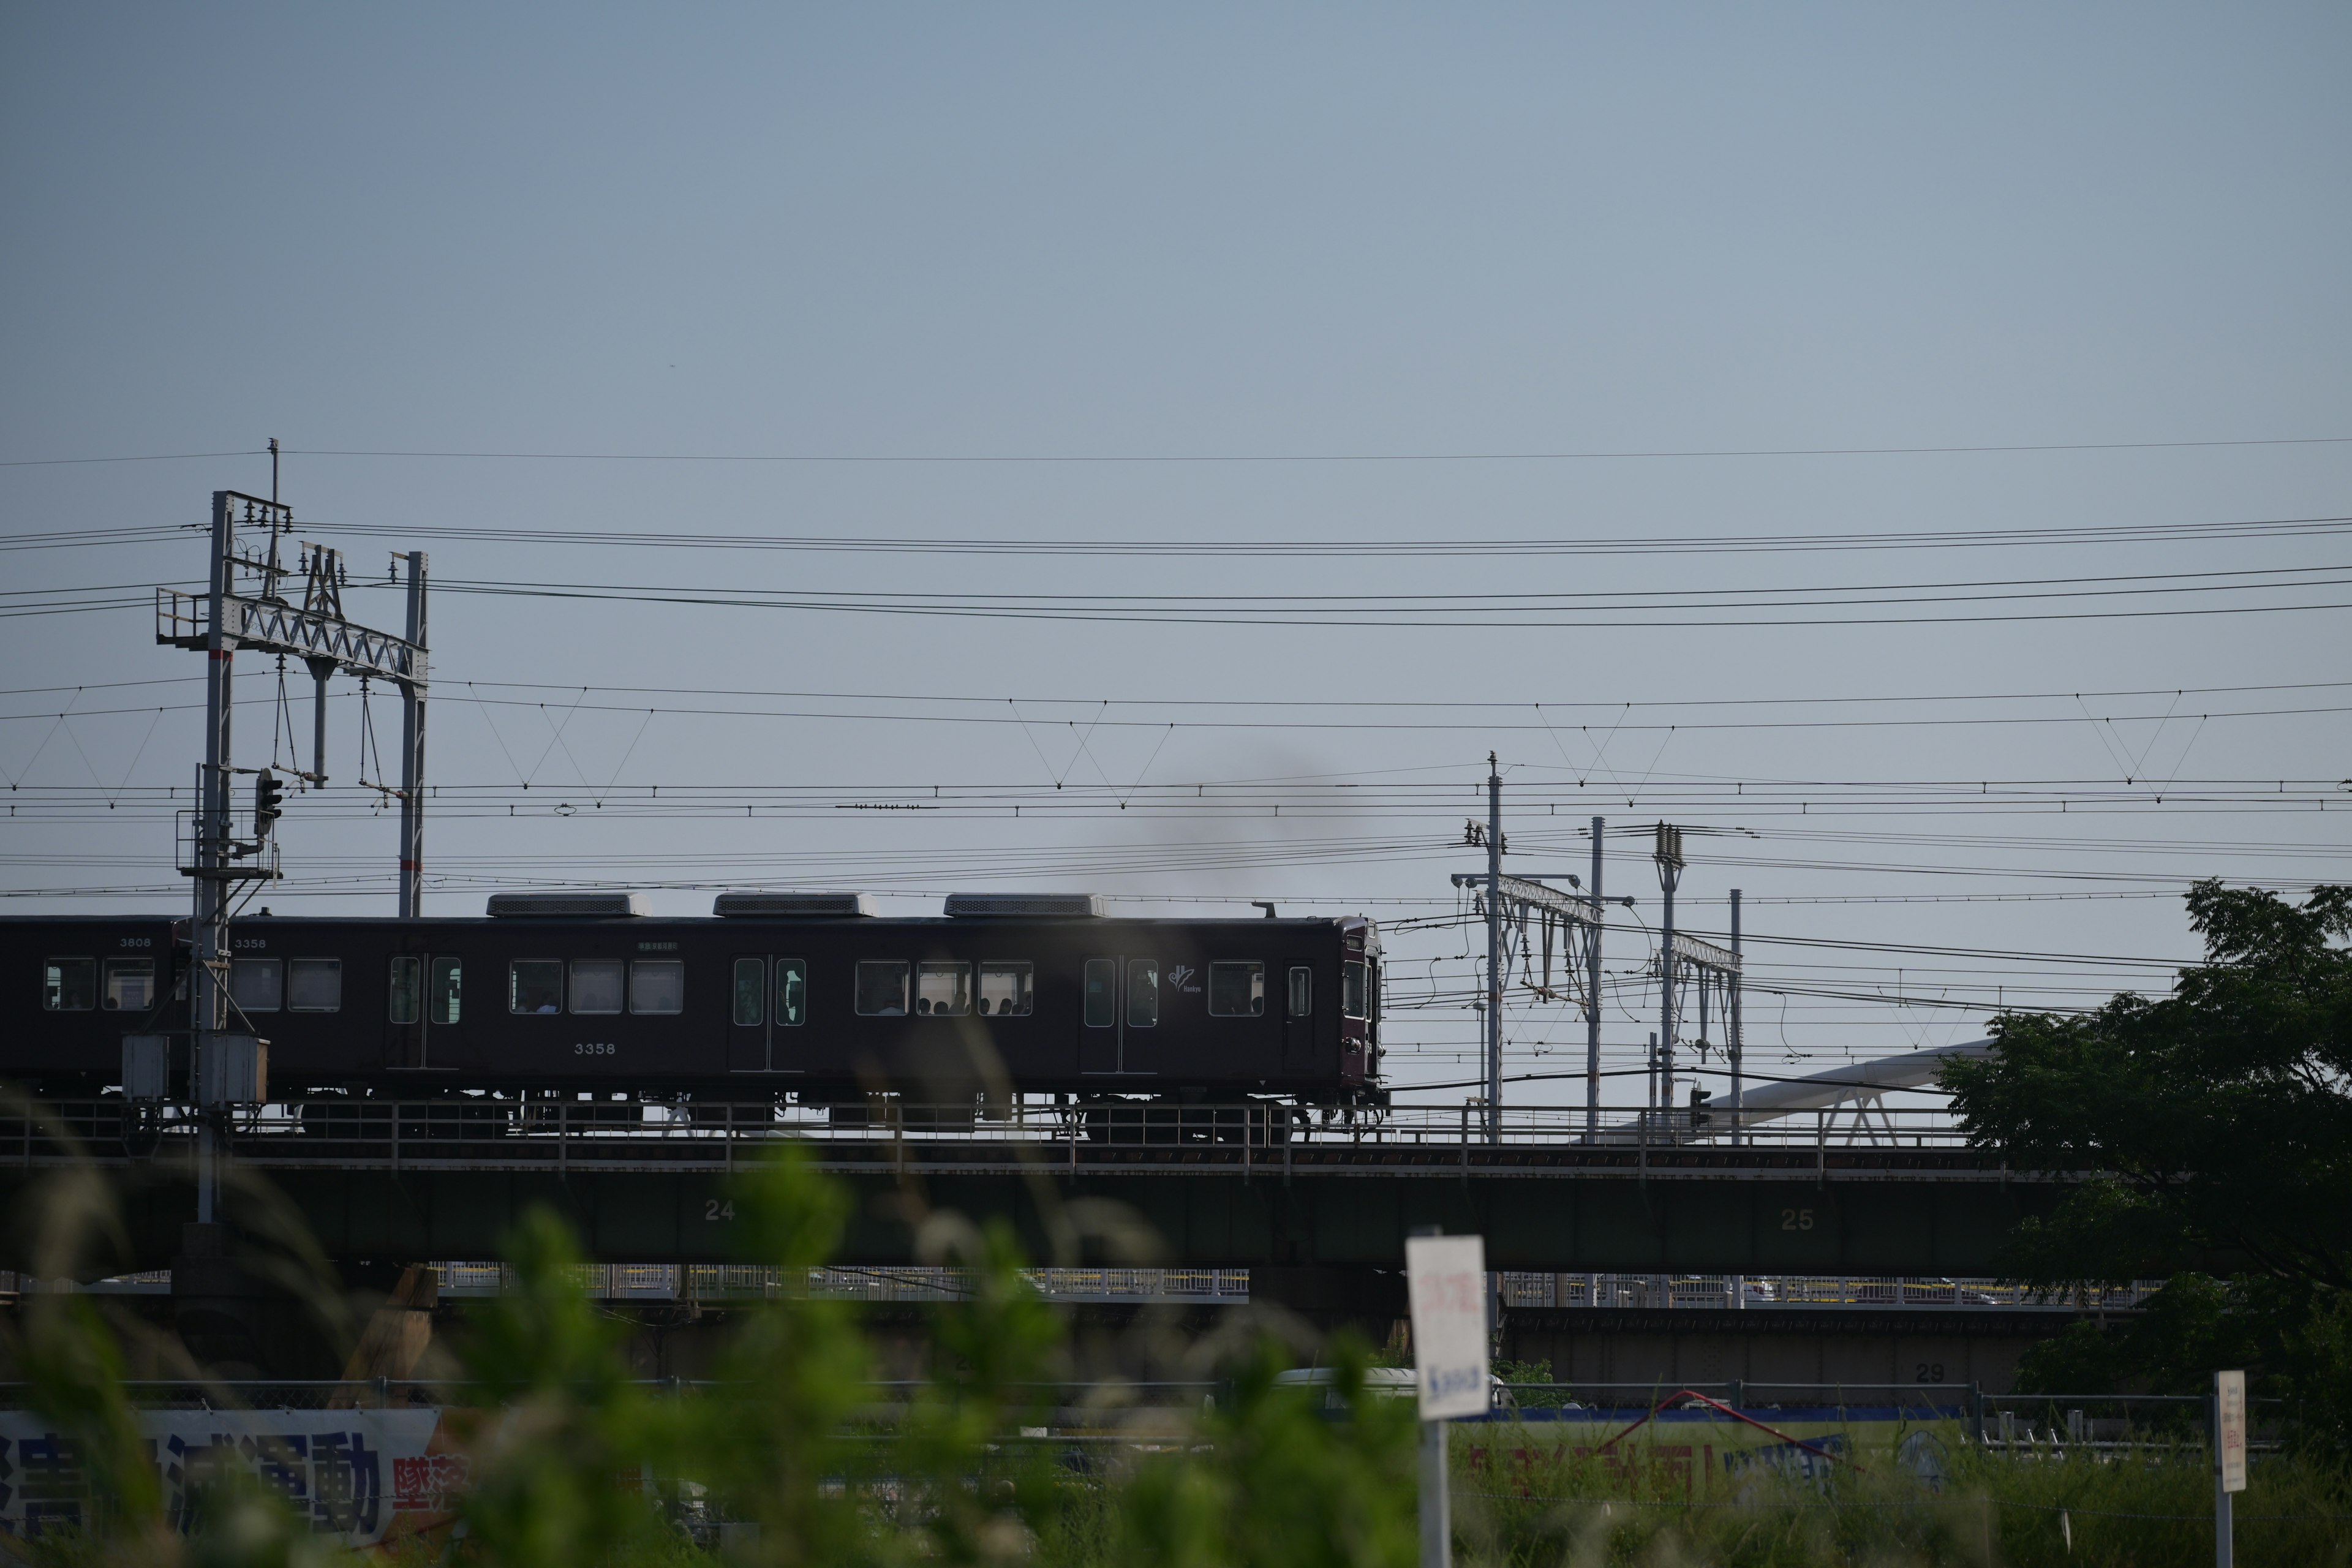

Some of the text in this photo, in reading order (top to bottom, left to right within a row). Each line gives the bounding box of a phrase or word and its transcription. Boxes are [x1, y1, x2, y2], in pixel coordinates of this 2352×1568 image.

[119, 938, 151, 948] 3808
[235, 939, 266, 949] 3358
[1183, 985, 1201, 993] Hankyu
[574, 1042, 616, 1055] 3358
[704, 1199, 734, 1221] 24
[1781, 1208, 1814, 1231] 25
[1916, 1363, 1945, 1383] 29
